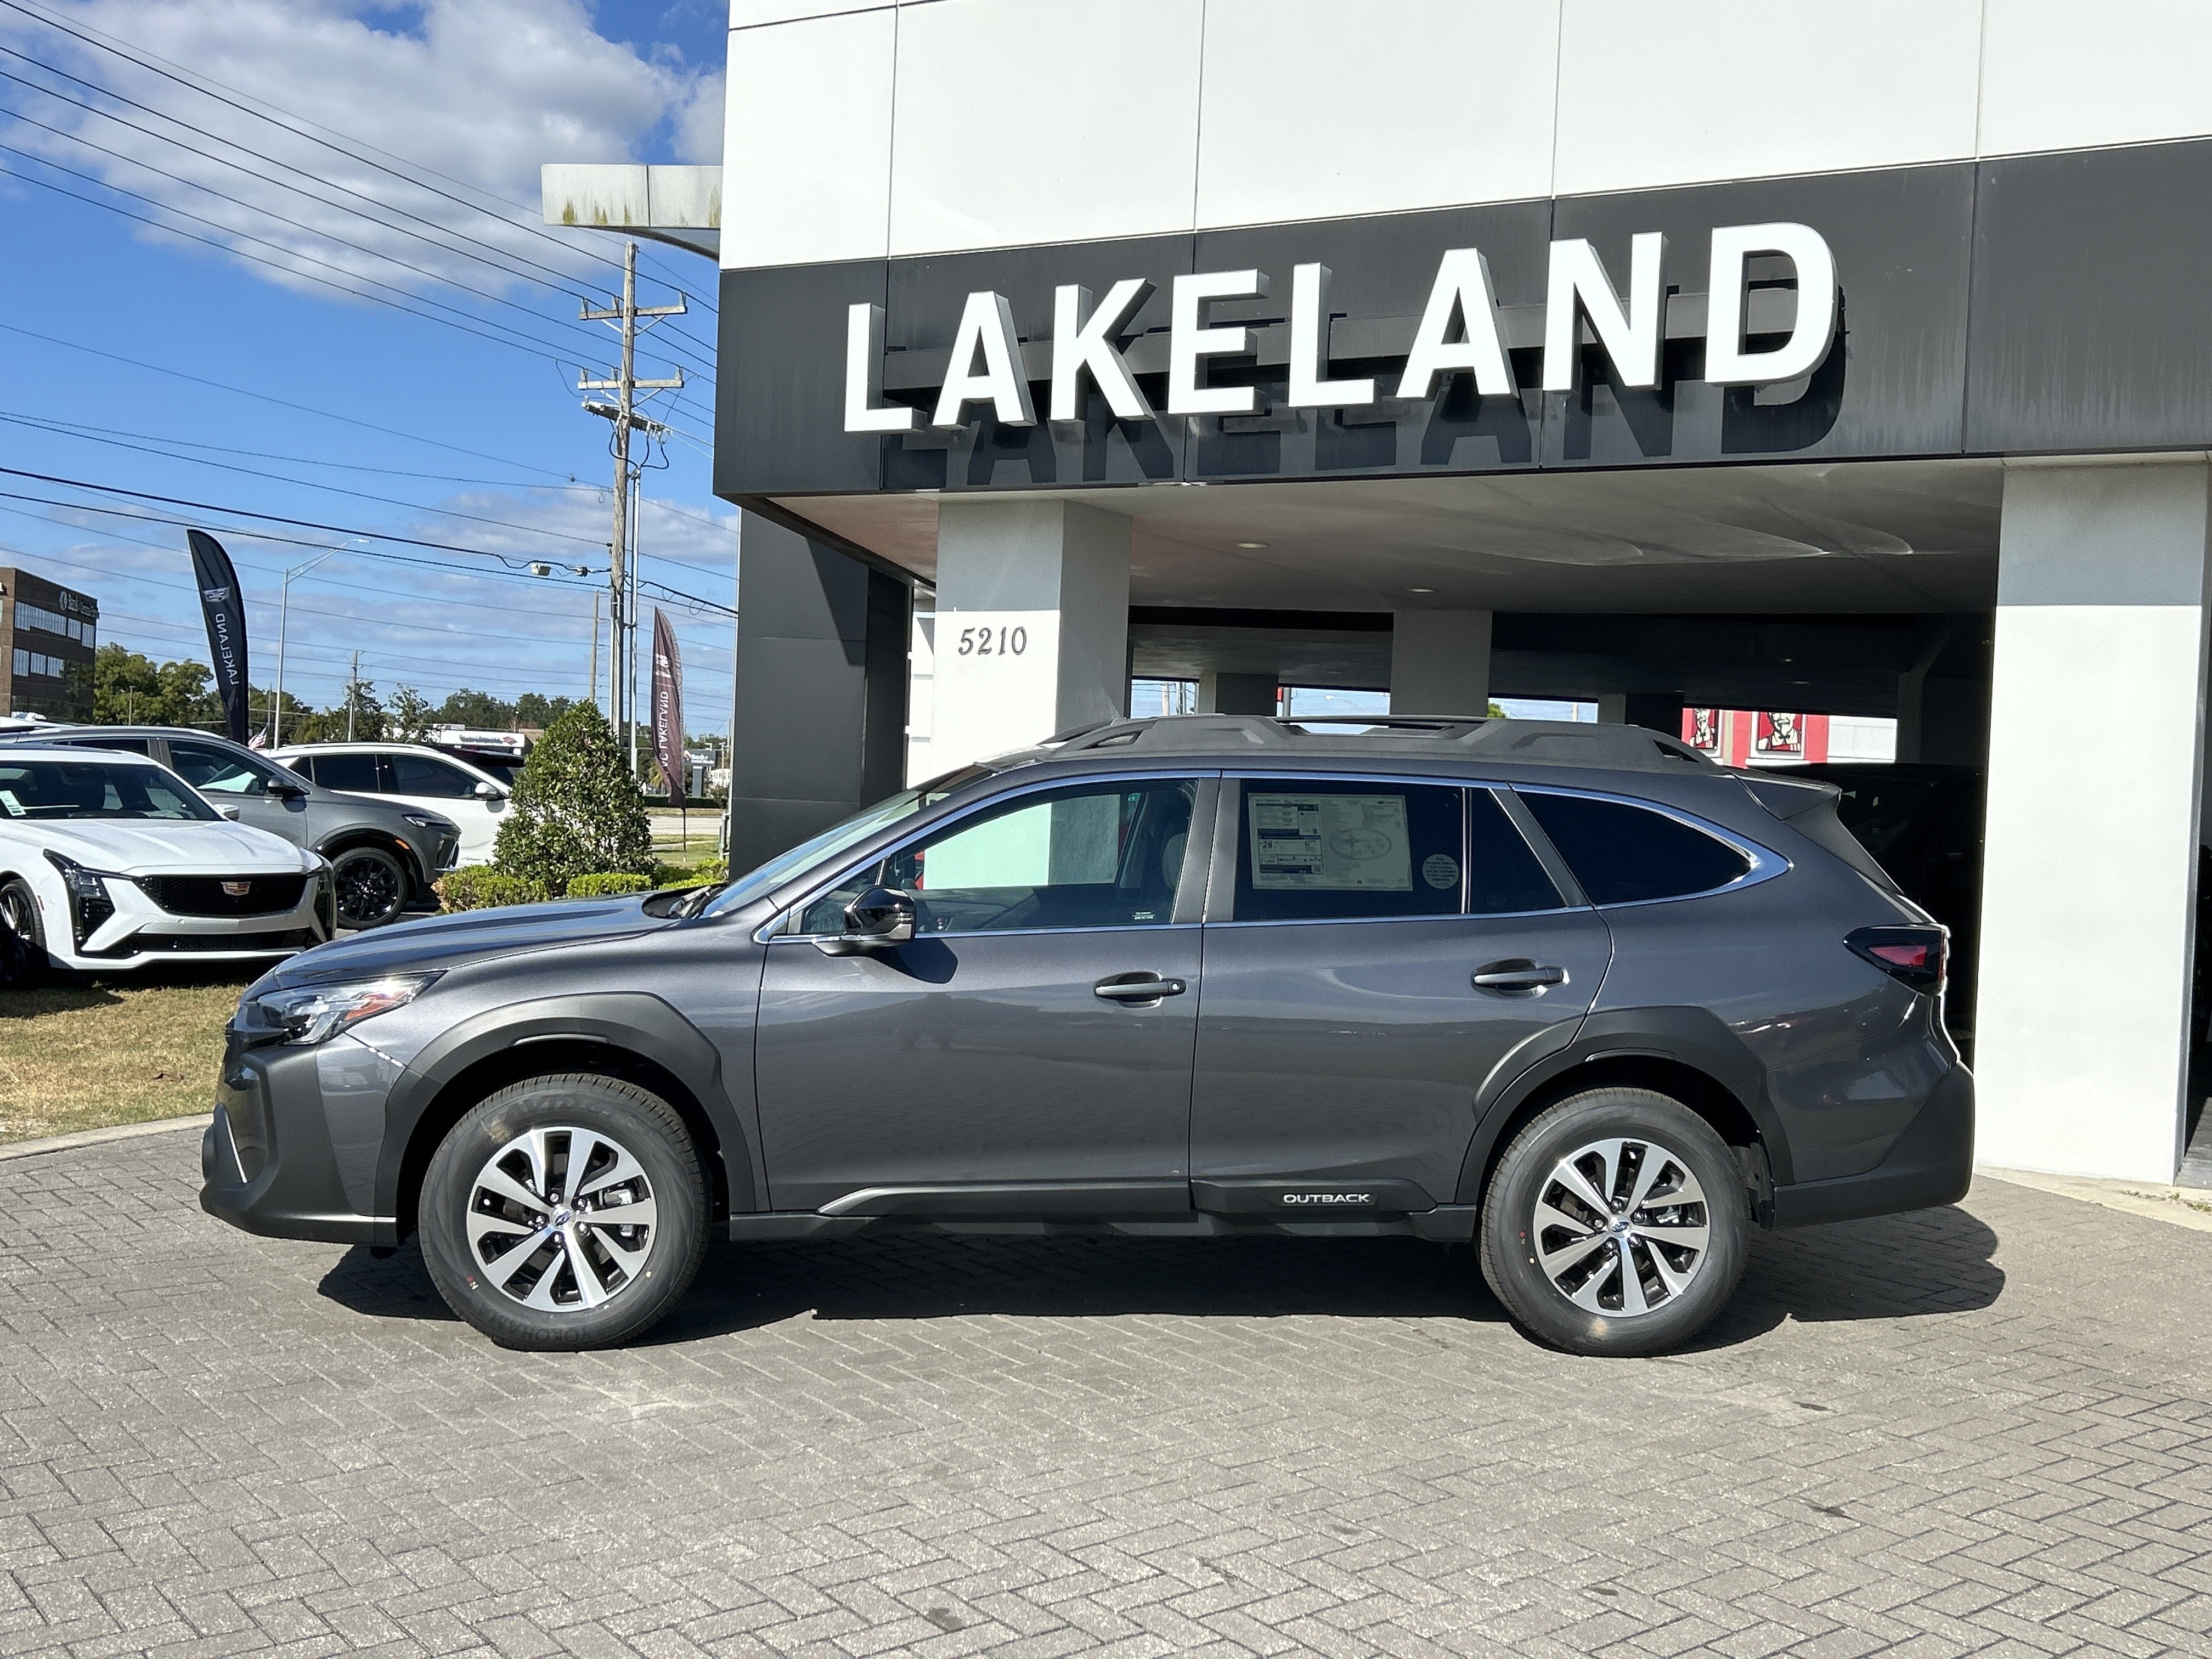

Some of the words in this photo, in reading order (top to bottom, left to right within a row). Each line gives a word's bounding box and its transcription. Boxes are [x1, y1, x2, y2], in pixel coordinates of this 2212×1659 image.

[844, 222, 1839, 434] LAKELAND
[958, 626, 1027, 656] 5210
[1283, 1194, 1370, 1203] OUTBACK
